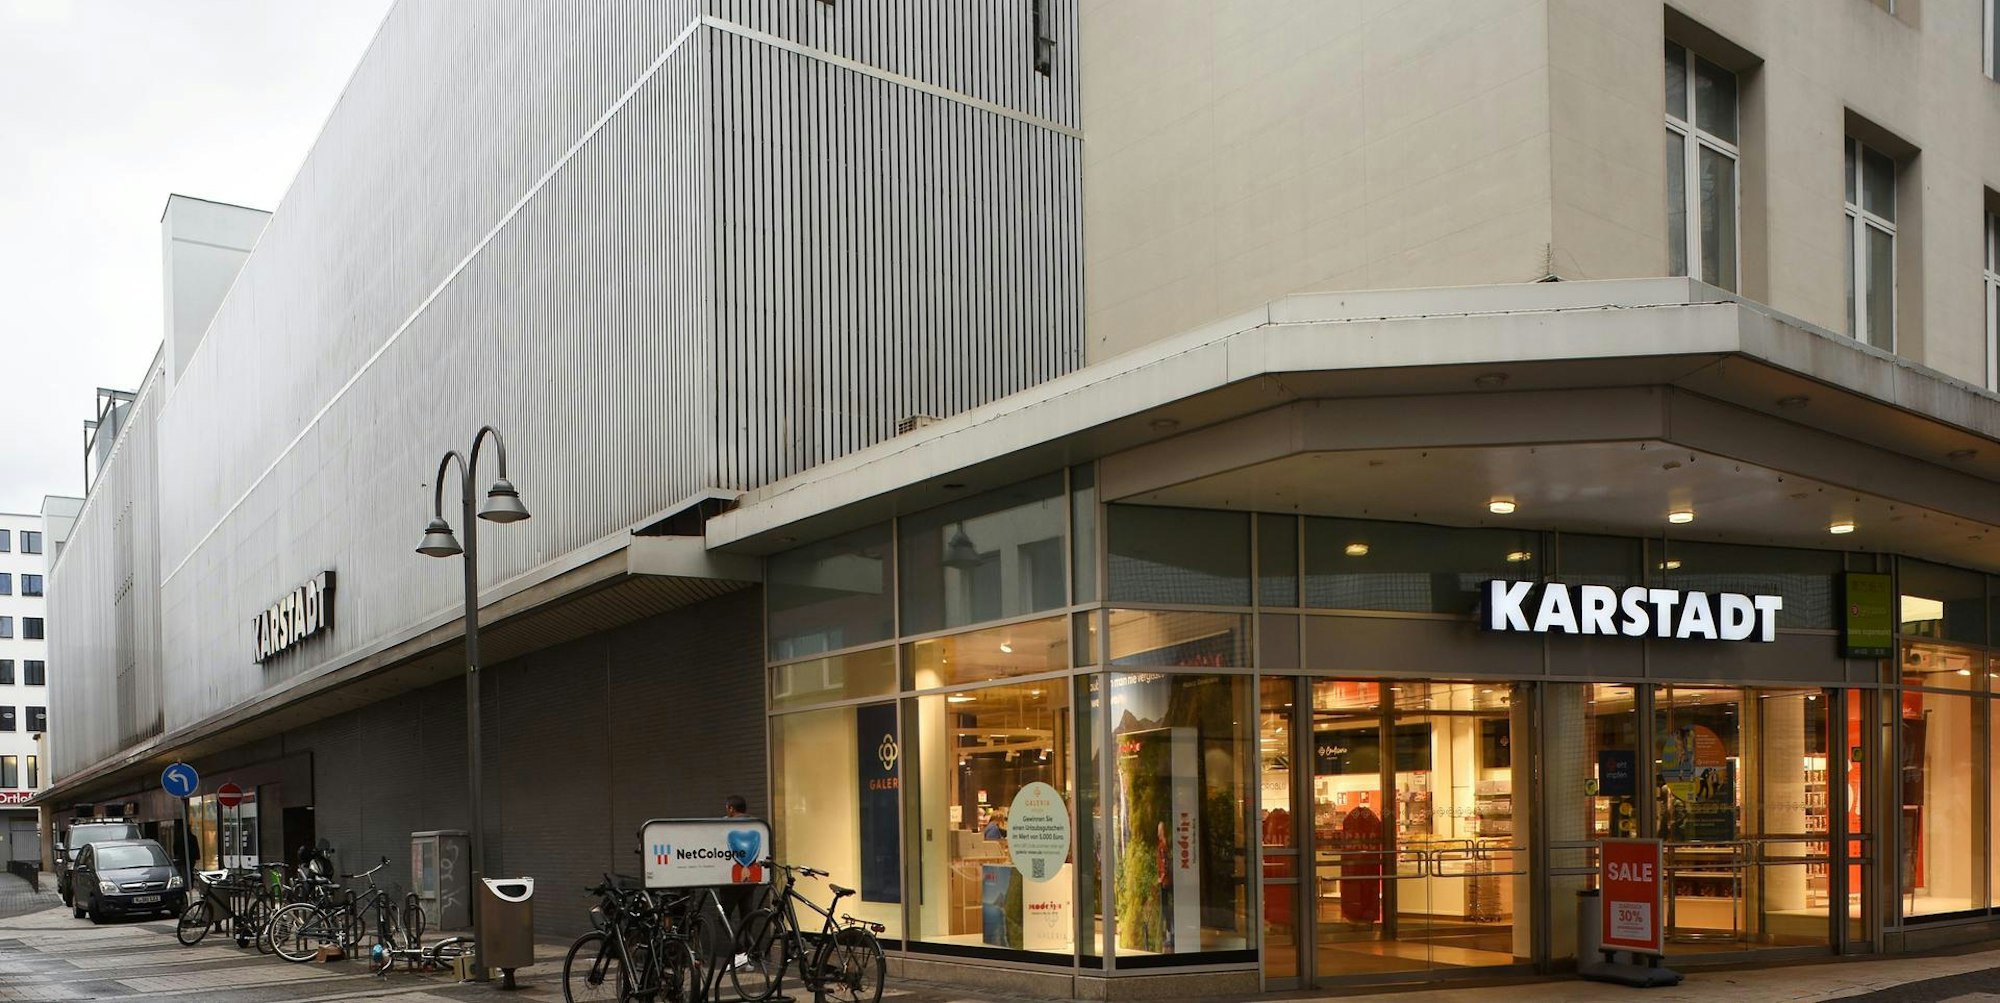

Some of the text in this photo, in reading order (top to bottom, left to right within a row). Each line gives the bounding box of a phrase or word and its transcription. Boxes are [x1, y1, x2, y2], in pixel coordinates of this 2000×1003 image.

[252, 571, 333, 663] KARSTADT
[1490, 579, 1783, 642] KARSTADT
[676, 848, 746, 861] NetCologne
[1608, 862, 1653, 882] SALE
[1618, 909, 1643, 922] 30%
